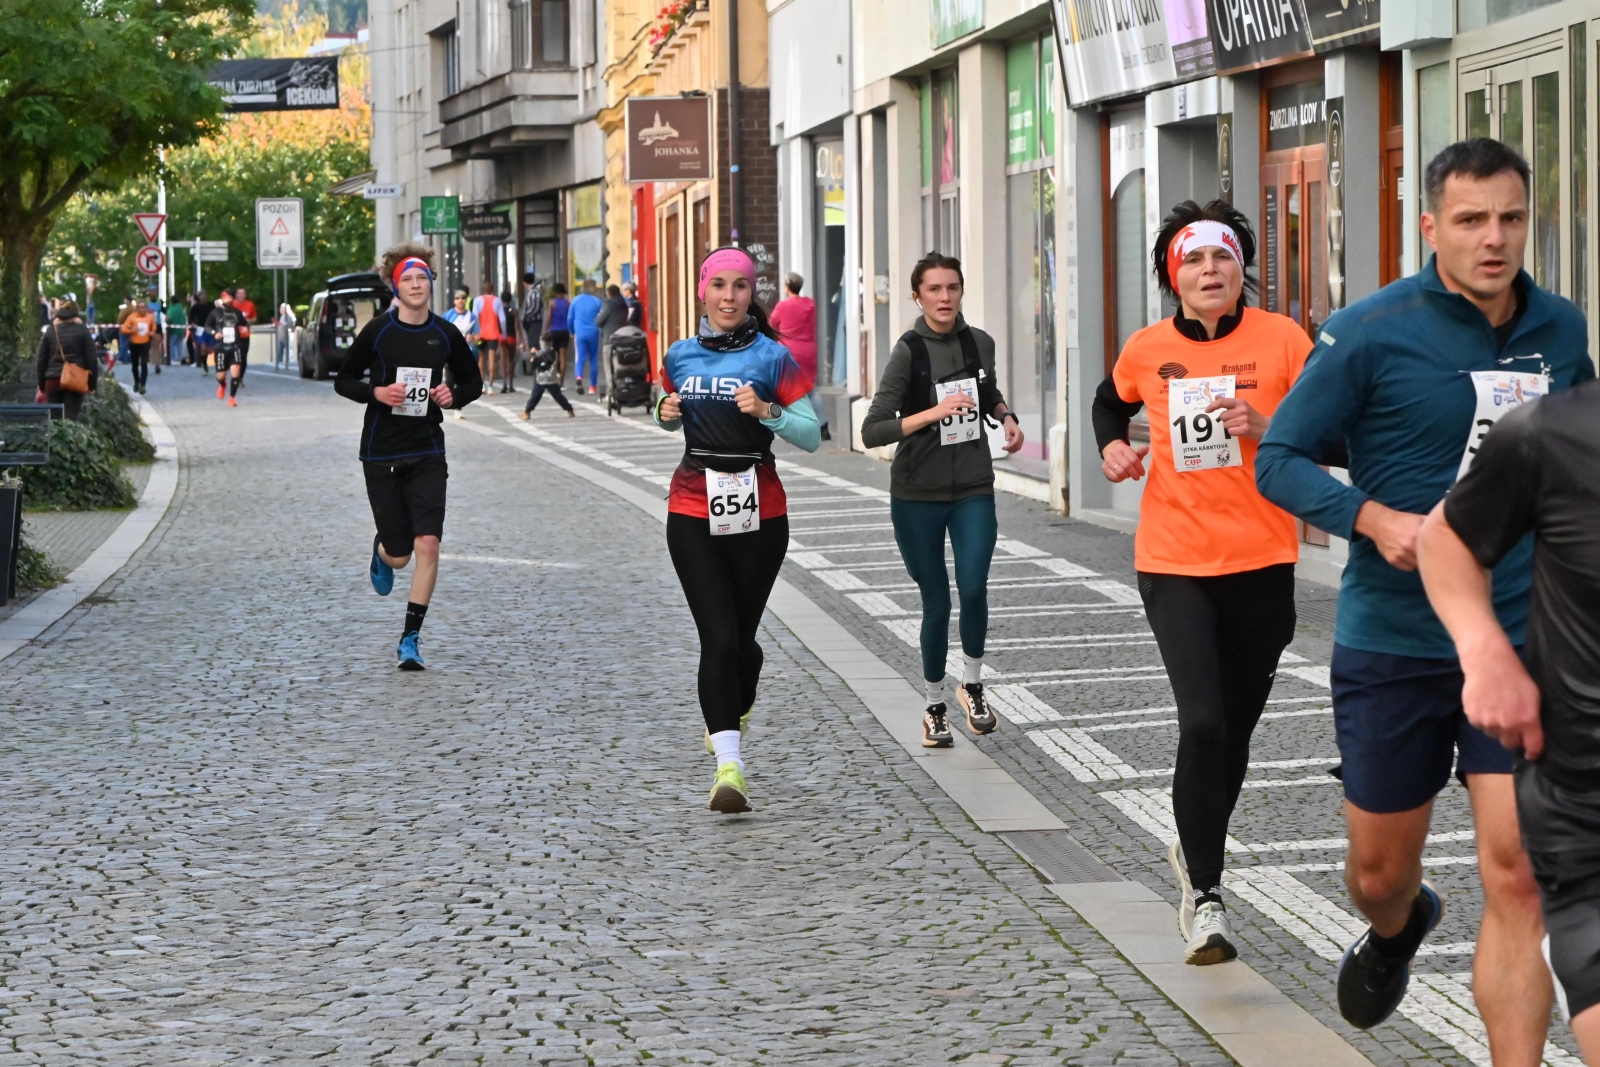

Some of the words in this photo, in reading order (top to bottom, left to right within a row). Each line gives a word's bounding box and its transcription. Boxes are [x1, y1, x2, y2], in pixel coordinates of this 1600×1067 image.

[1269, 106, 1298, 131] ZMRZLINA
[1300, 102, 1318, 126] LODY
[654, 147, 699, 157] JOHANKA
[262, 203, 297, 214] POZOR
[710, 493, 758, 517] 654
